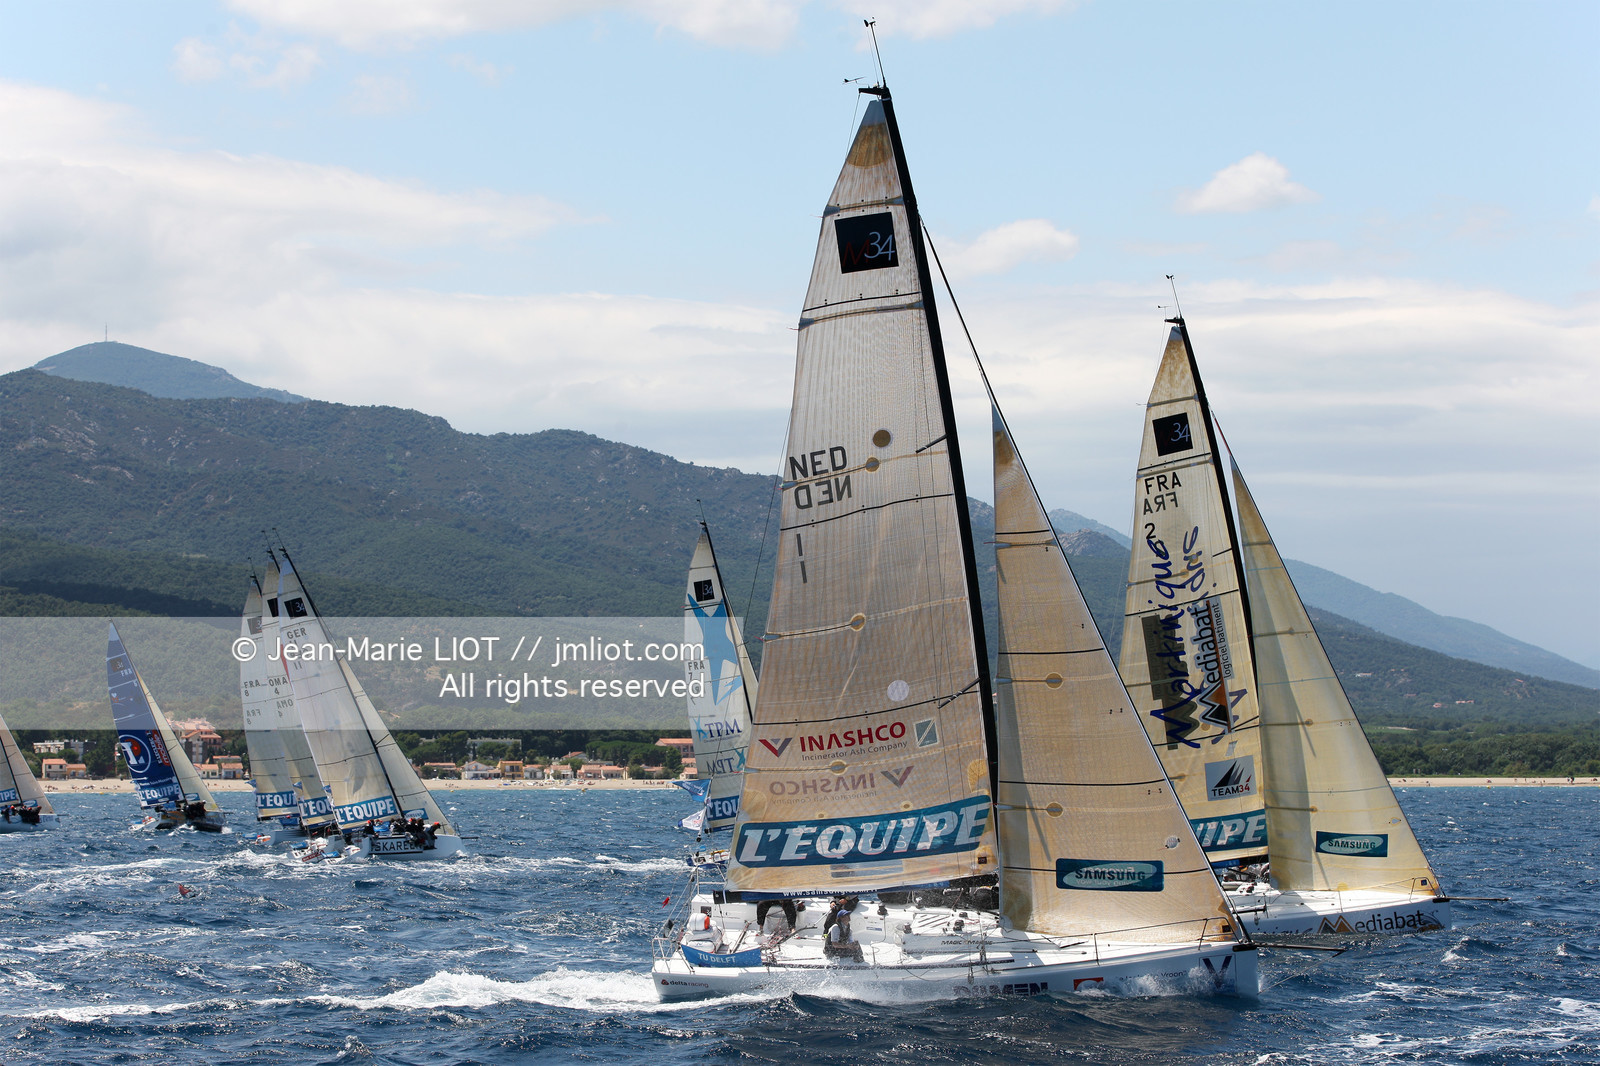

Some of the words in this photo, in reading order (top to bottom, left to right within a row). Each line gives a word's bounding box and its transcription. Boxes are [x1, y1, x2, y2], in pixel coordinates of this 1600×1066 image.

[789, 445, 847, 480] NED
[1144, 471, 1182, 494] FRA
[1144, 522, 1156, 539] 2
[1211, 602, 1226, 644] batiment
[287, 627, 307, 640] GER
[688, 661, 705, 671] FRA
[1218, 644, 1233, 679] logiciel
[243, 679, 261, 689] FRA
[268, 676, 289, 687] OMA
[704, 718, 743, 739] TPM
[800, 721, 906, 752] INASHCO
[801, 751, 848, 761] Incinerator
[849, 747, 866, 756] Ash
[867, 741, 908, 753] Company
[1211, 784, 1250, 797] TEAM34
[1328, 839, 1376, 849] SAMSUNG
[1075, 868, 1146, 881] SAMSUNG
[697, 952, 709, 961] TU
[711, 955, 737, 963] DELFT
